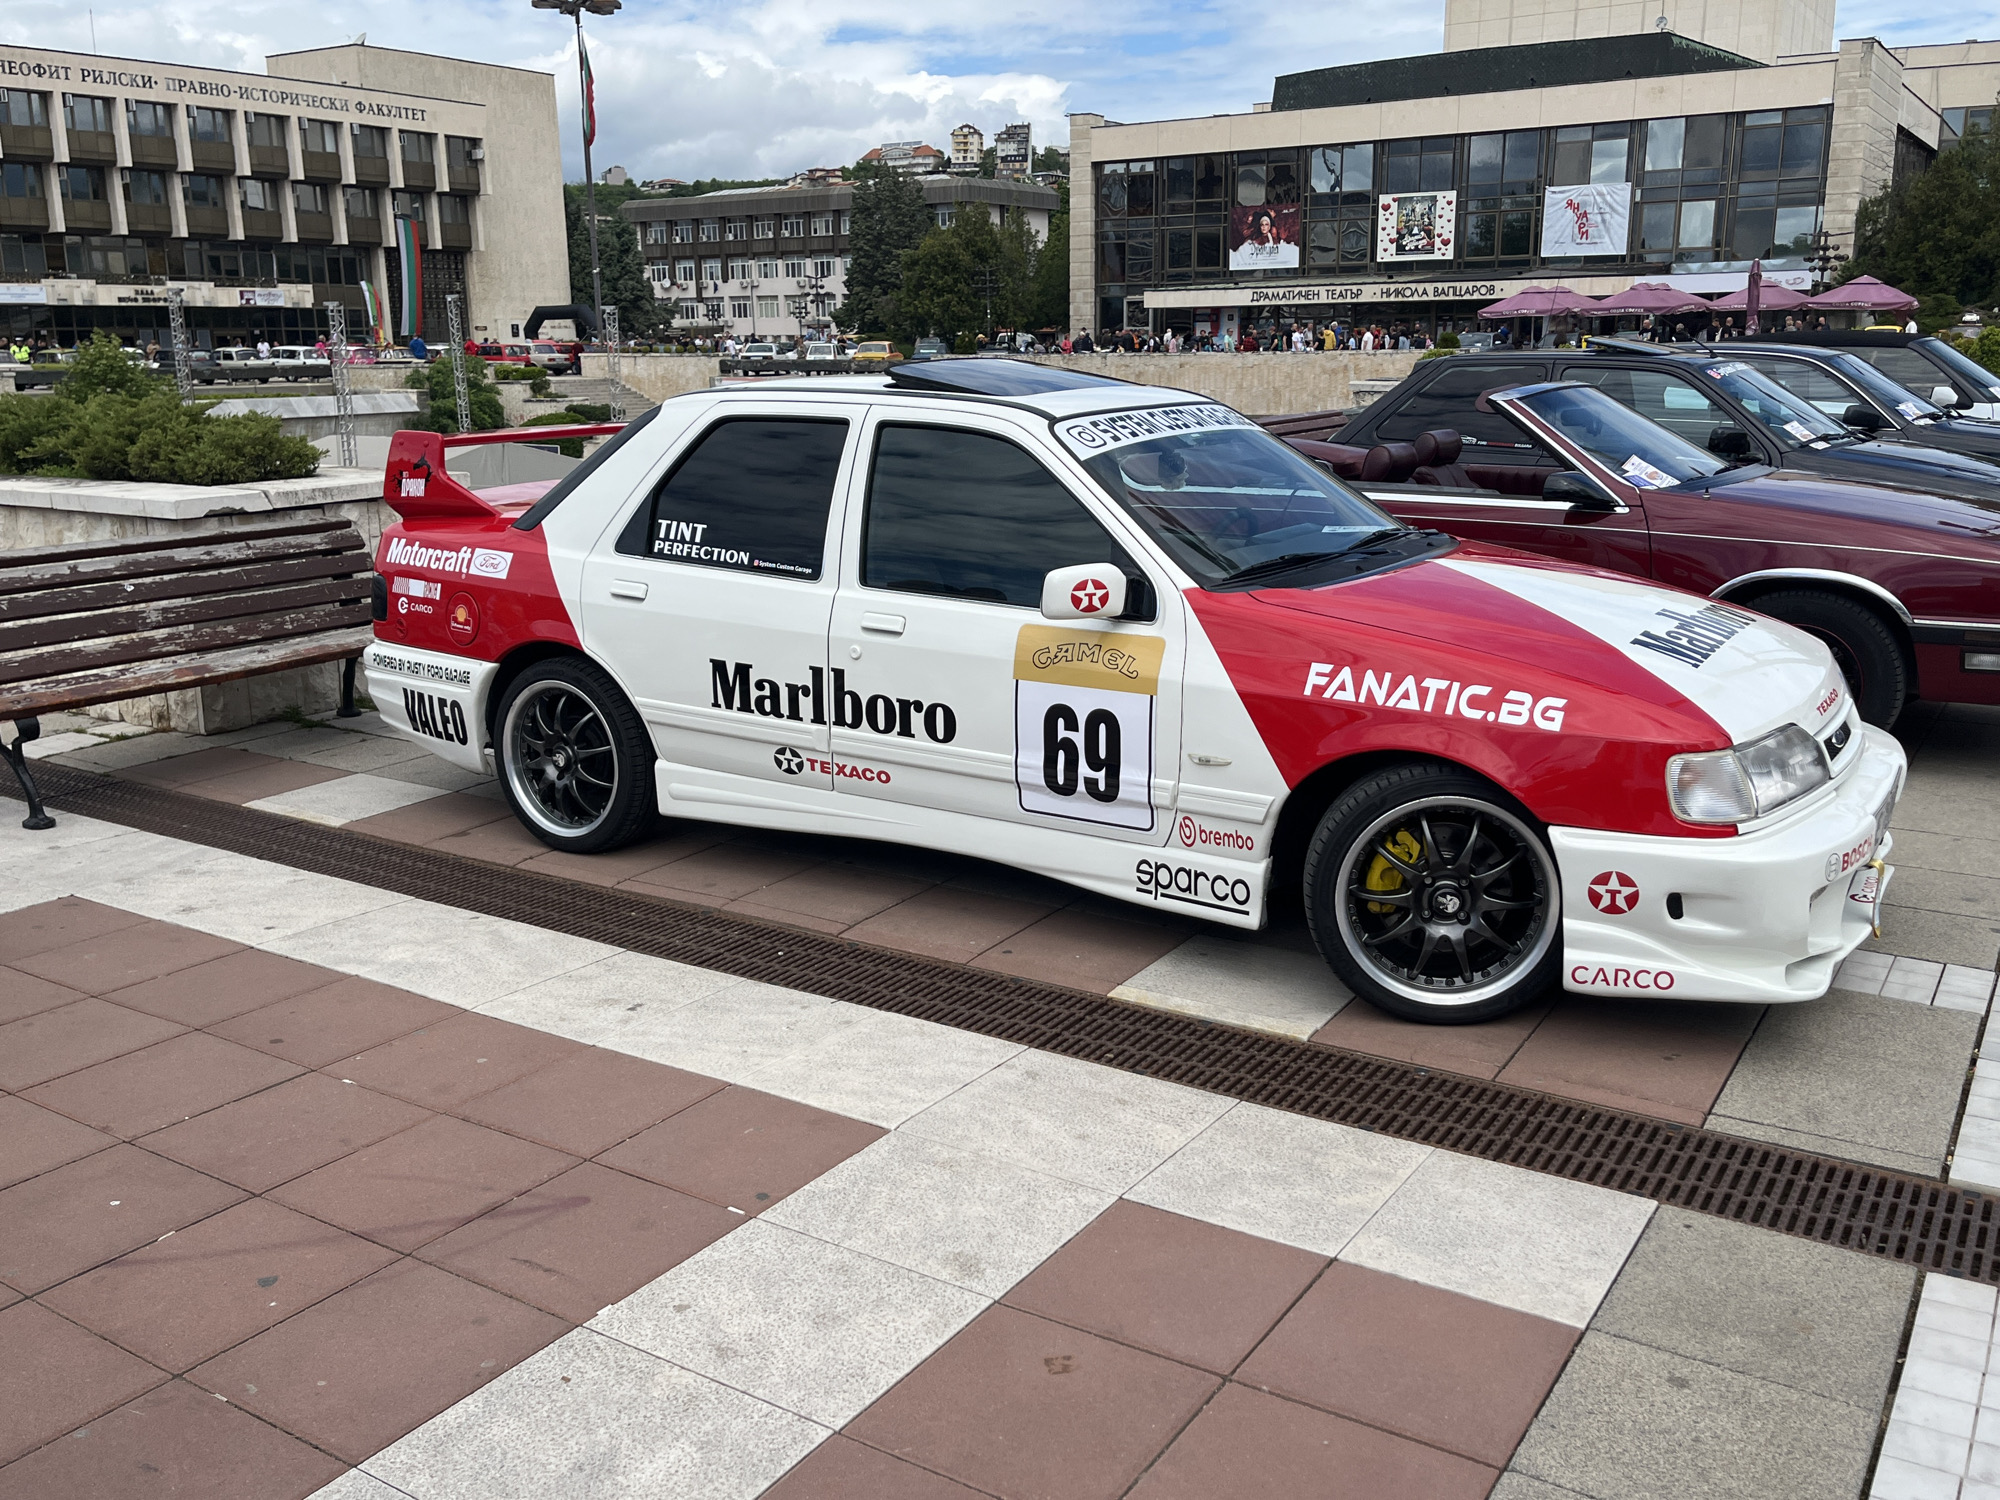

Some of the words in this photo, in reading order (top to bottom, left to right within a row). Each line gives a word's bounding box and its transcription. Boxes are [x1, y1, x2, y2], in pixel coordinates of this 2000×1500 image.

[165, 77, 349, 112] ПРАВНО-ИСТОРИЧЕСКИ
[355, 100, 427, 122] ФАКУЛТЕТ
[1250, 289, 1320, 303] ДРАМАТИЧЕН
[1325, 288, 1363, 300] ТЕАТЪР
[1380, 286, 1429, 299] НИКОЛА
[1433, 284, 1496, 297] ВАПЦАРОВ
[658, 519, 707, 543] TINT
[386, 537, 472, 573] Motorcraft
[480, 556, 501, 570] Ford
[653, 540, 750, 565] PERFECTION
[759, 560, 776, 568] System
[776, 563, 794, 571] Custom
[795, 565, 812, 574] Garage
[410, 602, 433, 614] CARCO
[1629, 604, 1757, 668] Marlboro
[373, 652, 397, 670] POWERED
[397, 658, 406, 671] BY
[406, 659, 427, 676] RUSTY
[427, 664, 444, 680] FORD
[444, 667, 471, 685] GARAGE
[1032, 643, 1139, 680] CAMEL
[709, 658, 957, 744] Marlboro
[1303, 662, 1568, 732] FANATIC.BG
[1816, 688, 1839, 717] TEXACO
[402, 687, 468, 746] VALEO
[1043, 703, 1121, 803] 69
[806, 757, 891, 784] TEXACO
[1198, 824, 1254, 851] brembo
[1136, 858, 1250, 906] sparco
[1571, 965, 1675, 991] CARCO
